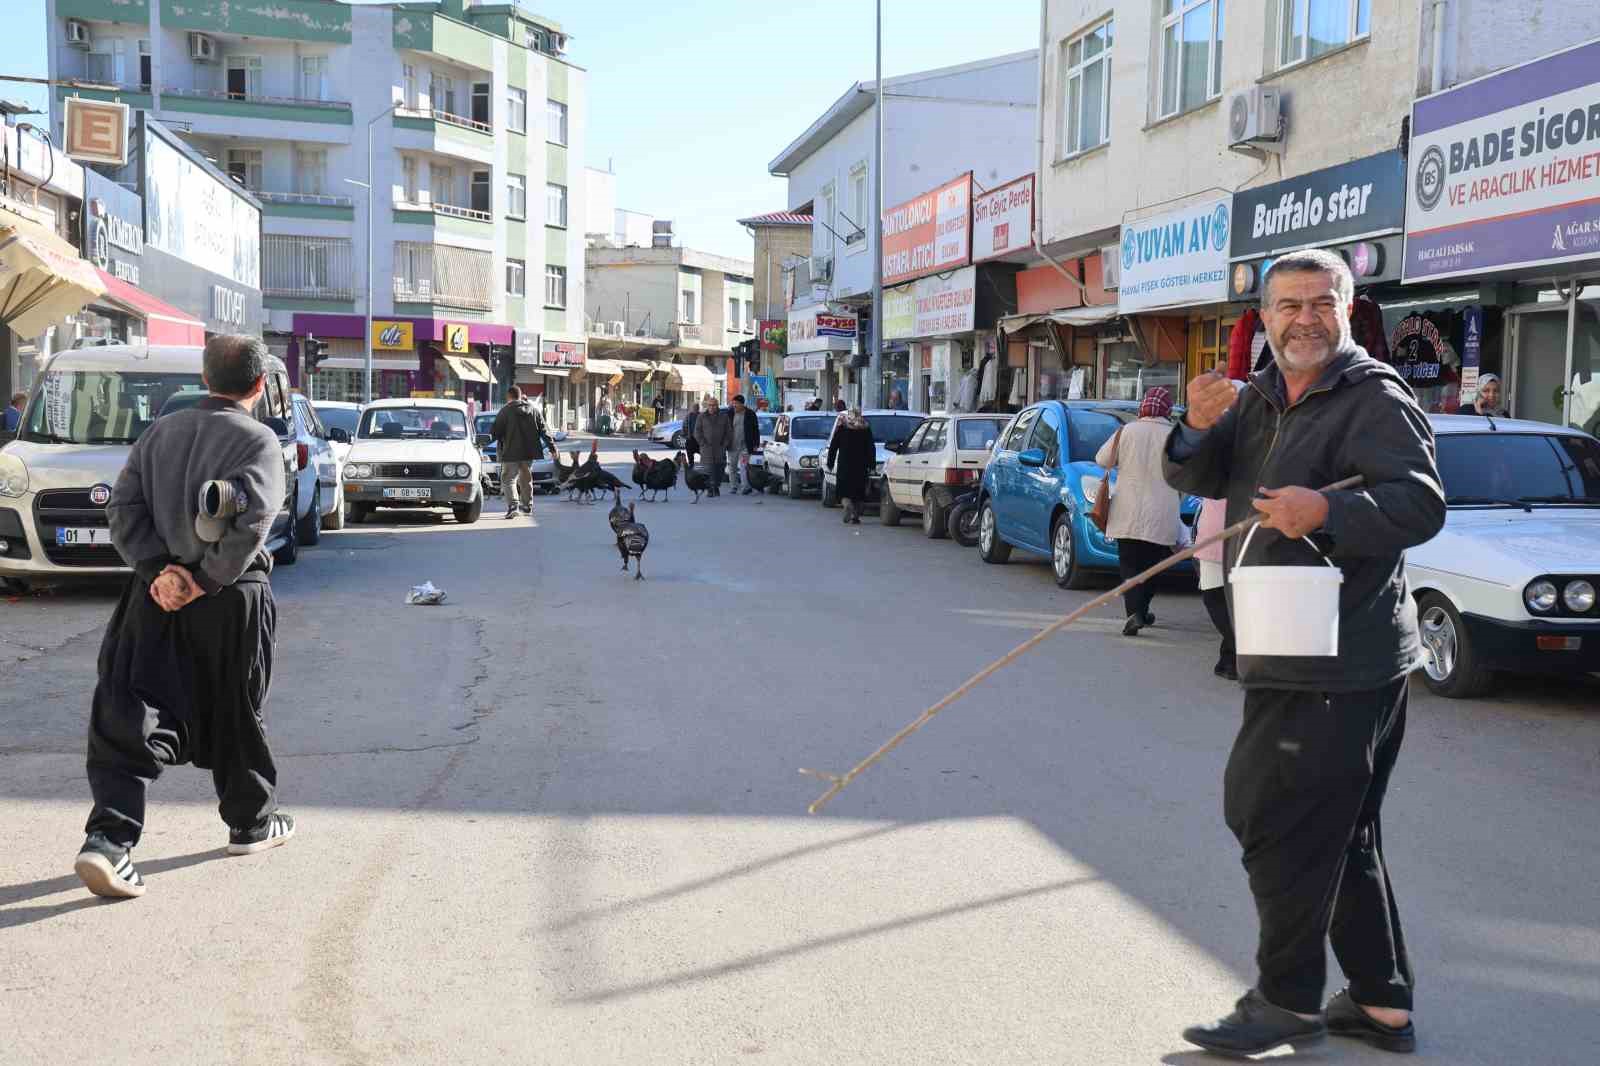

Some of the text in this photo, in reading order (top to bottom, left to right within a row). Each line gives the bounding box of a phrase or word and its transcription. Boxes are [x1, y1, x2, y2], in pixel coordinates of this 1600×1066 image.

[81, 113, 111, 149] E
[1449, 127, 1515, 175] BADE
[1009, 184, 1030, 209] Perde
[1449, 184, 1466, 206] VE
[1469, 167, 1536, 202] ARACILIK
[1252, 183, 1373, 239] Buffalo star
[1136, 214, 1212, 263] YUVAM AV
[882, 249, 910, 277] USTAFA
[66, 529, 78, 542] 01
